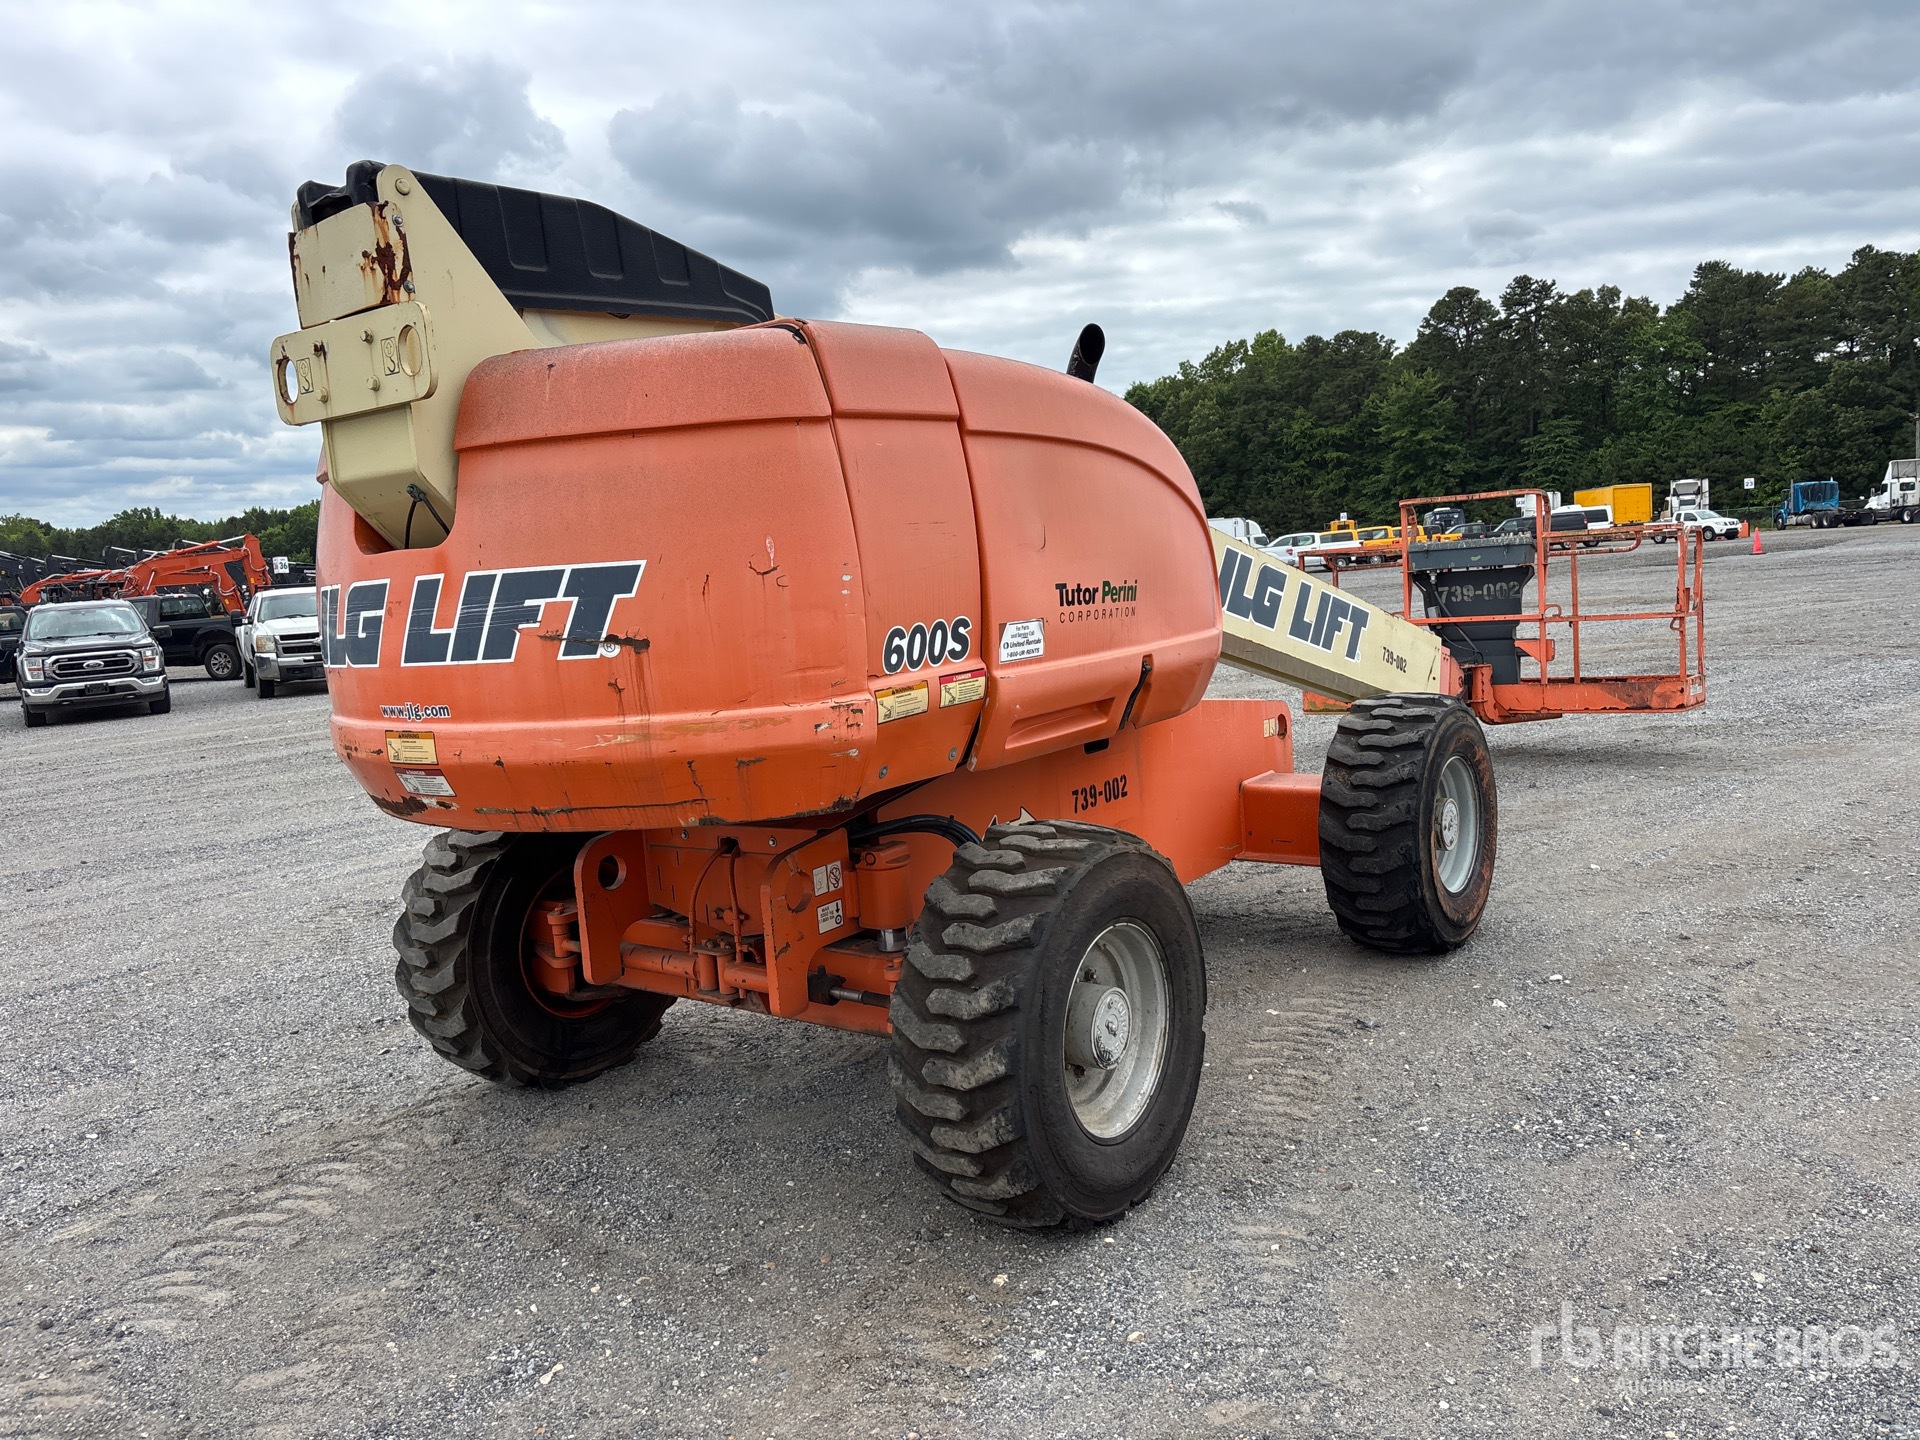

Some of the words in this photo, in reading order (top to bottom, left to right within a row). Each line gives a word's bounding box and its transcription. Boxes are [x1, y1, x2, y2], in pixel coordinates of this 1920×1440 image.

[1054, 583, 1099, 607] Tutor
[1101, 579, 1138, 604] Perini
[1437, 581, 1521, 604] 739-002
[401, 560, 647, 667] LIFT
[1059, 606, 1136, 624] CORPORATION
[1287, 579, 1371, 662] LIFT
[883, 616, 972, 674] 600S
[1006, 648, 1040, 658] 1-800-UR-RENTS
[1382, 645, 1408, 674] 739-002
[380, 703, 451, 721] www.jlg.com
[1071, 774, 1128, 814] 739-002
